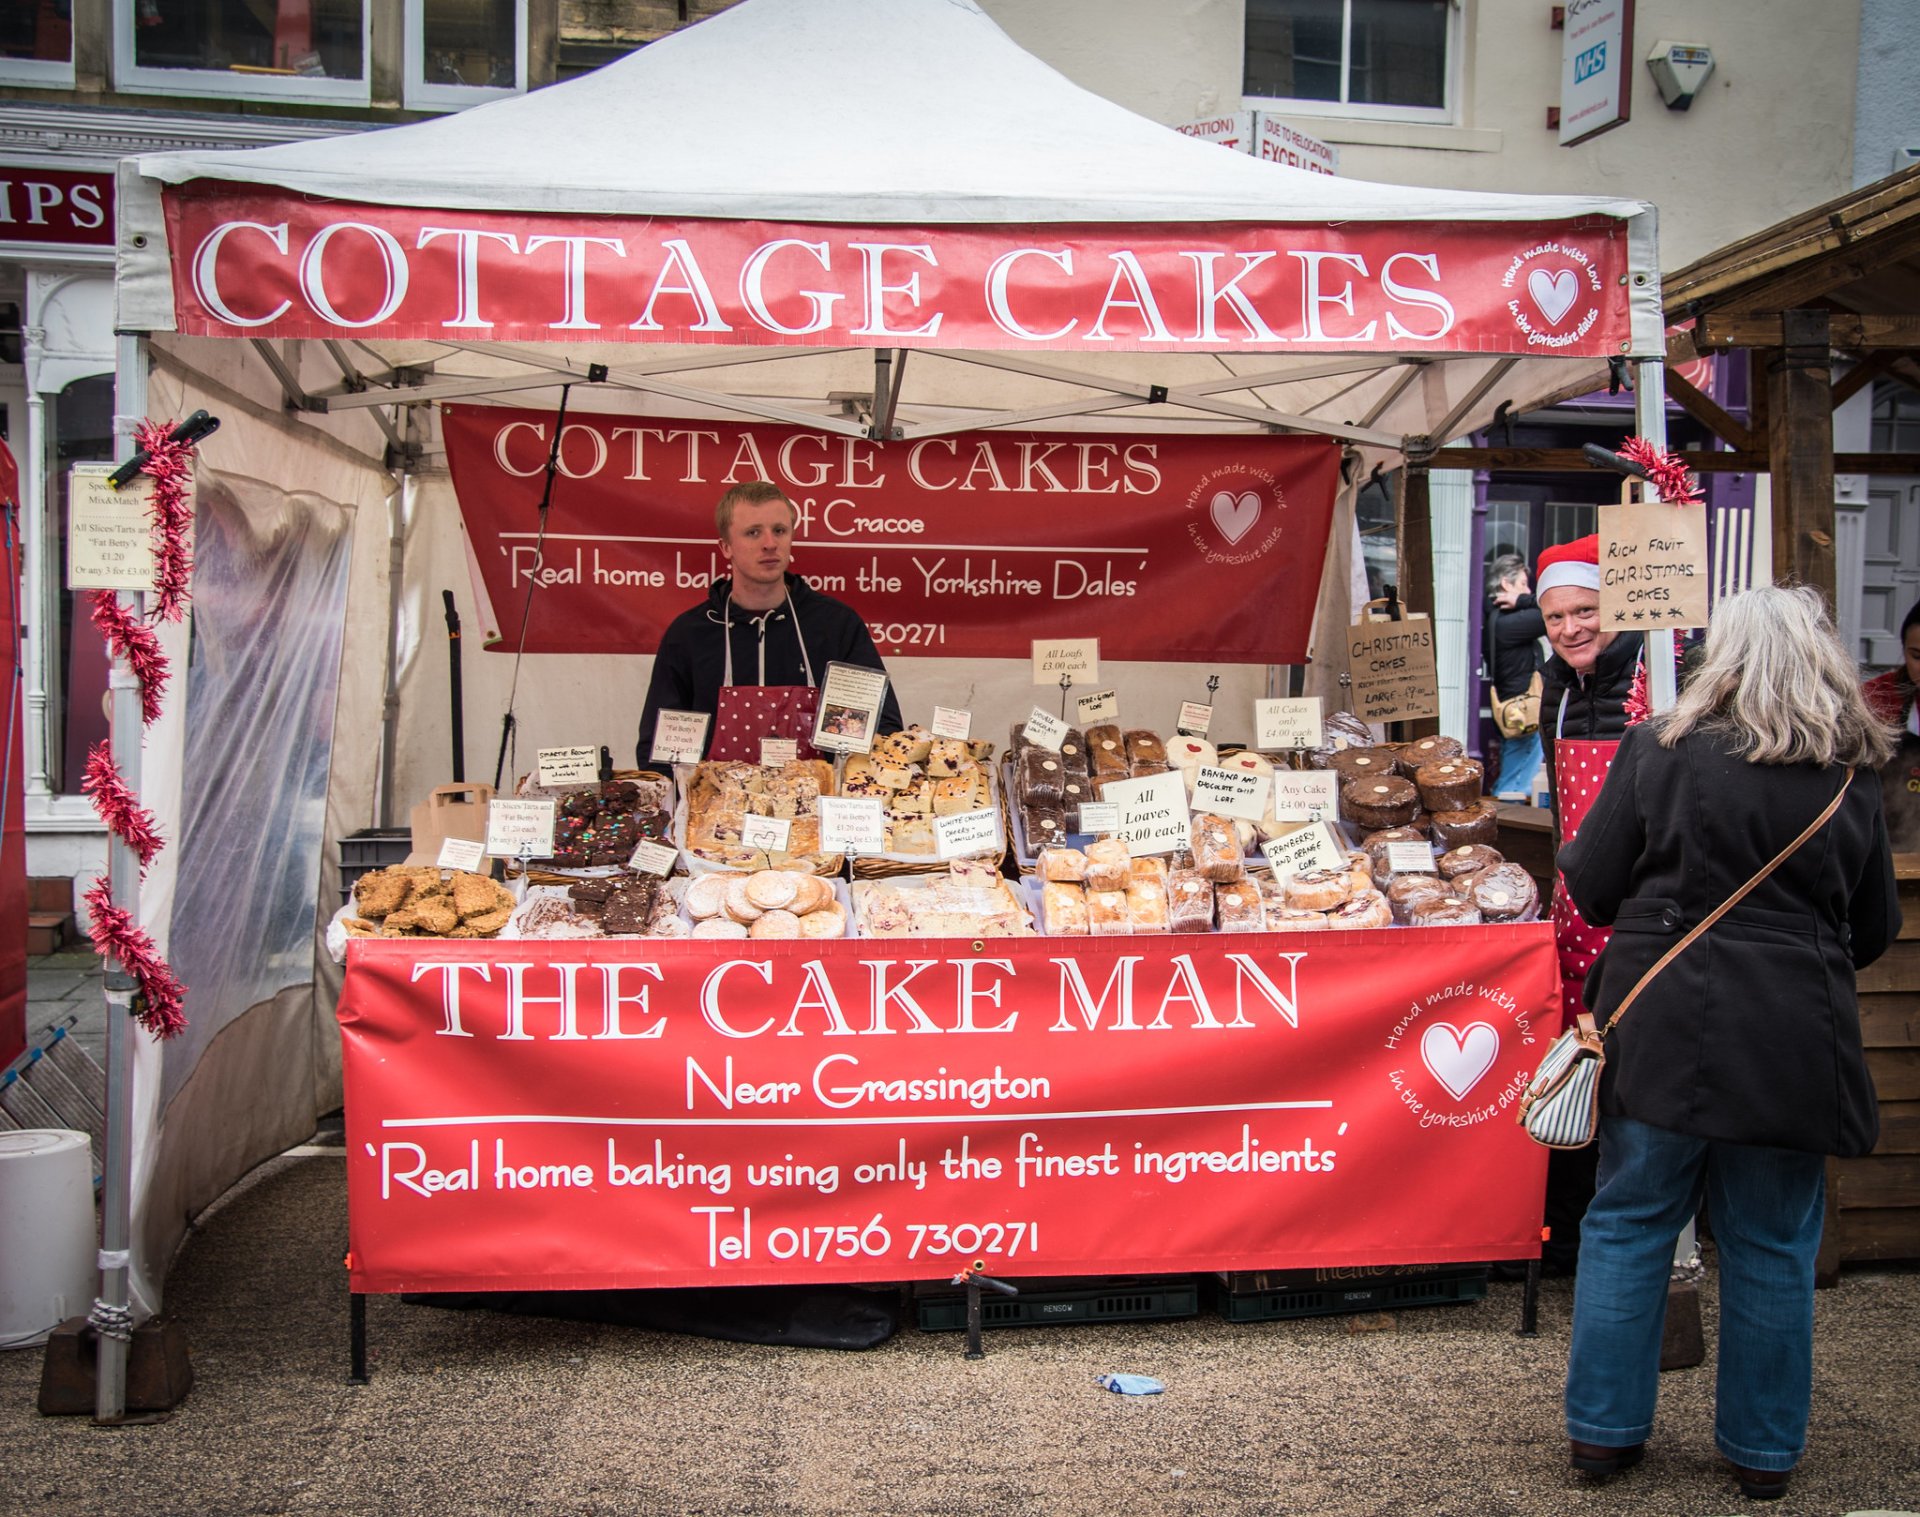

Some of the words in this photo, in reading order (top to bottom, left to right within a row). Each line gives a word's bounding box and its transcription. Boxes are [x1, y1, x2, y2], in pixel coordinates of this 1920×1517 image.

[1576, 43, 1606, 82] NHS
[1282, 126, 1291, 142] TO
[1291, 132, 1333, 165] RELOCATION)
[0, 181, 105, 229] IPS
[1501, 255, 1525, 288] Hand
[1523, 241, 1559, 260] made
[1561, 245, 1588, 266] with
[1586, 263, 1602, 292] love
[191, 220, 944, 338] COTTAGE
[984, 247, 1455, 344] CAKES
[1507, 300, 1519, 316] in
[1516, 313, 1532, 334] the
[1527, 329, 1579, 348] yorkshire
[1577, 308, 1599, 337] dales
[493, 421, 886, 488] COTTAGE
[907, 438, 1162, 496] CAKES
[1185, 474, 1210, 510] Hand
[1211, 462, 1246, 479] made
[1249, 466, 1275, 486] with
[1272, 485, 1288, 510] love
[88, 496, 139, 505] Mix&Match
[823, 498, 925, 536] Cracoe
[74, 524, 87, 532] All
[108, 539, 138, 549] Betty's
[1187, 522, 1198, 537] in
[1193, 535, 1209, 553] the
[1205, 549, 1262, 565] yorkshire
[1261, 526, 1282, 553] dales
[1607, 542, 1638, 559] RICH
[1648, 538, 1685, 551] FRUIT
[101, 553, 125, 561] £1.20
[75, 566, 86, 574] Or
[88, 568, 102, 576] any
[113, 567, 125, 575] for
[594, 548, 666, 587] home
[676, 551, 732, 590] baki
[856, 556, 903, 593] the
[912, 557, 1042, 598] Yorkshire
[1604, 564, 1695, 586] CHRISTMAS
[1626, 587, 1670, 603] CAKES
[866, 622, 945, 647] 30271
[1351, 632, 1430, 658] CHRISTMAS
[1045, 650, 1058, 659] All
[1370, 657, 1406, 672] CAKES
[1042, 662, 1065, 671] £3.00
[1067, 661, 1087, 671] each
[1365, 690, 1397, 704] LARGE
[1266, 706, 1280, 714] All
[1282, 705, 1308, 715] Cakes
[1278, 715, 1298, 727] only
[1265, 729, 1290, 738] £4.00
[1292, 728, 1312, 738] each
[1197, 780, 1233, 792] CHOCOLATE
[1201, 768, 1239, 782] BANANA
[1242, 775, 1258, 784] AND
[1135, 789, 1155, 805] All
[1214, 794, 1235, 804] LOAF
[1281, 785, 1301, 796] Any
[1303, 785, 1327, 794] Cake
[1280, 800, 1306, 809] £4.00
[1309, 801, 1329, 810] each
[940, 816, 963, 828] WHITE
[964, 811, 995, 822] CHOCOLATE
[1125, 808, 1170, 825] Loaves
[1155, 821, 1185, 838] each
[1267, 831, 1315, 858] CRANBERRY
[1275, 855, 1292, 867] AND
[1294, 841, 1322, 860] ORANGE
[410, 961, 668, 1041] THE
[699, 958, 1019, 1039] CAKE
[1048, 952, 1308, 1033] MAN
[1384, 1002, 1423, 1050] Hand
[1425, 981, 1473, 1006] made
[1479, 985, 1517, 1013] with
[1515, 1011, 1536, 1045] love
[686, 1055, 801, 1110] Near
[813, 1054, 1051, 1109] Grassington
[1389, 1069, 1405, 1091] in
[1401, 1089, 1424, 1114] the
[1419, 1103, 1499, 1128] yorkshire
[1498, 1070, 1528, 1109] dales
[494, 1138, 594, 1190] home
[607, 1138, 732, 1195] baking
[747, 1153, 840, 1195] using
[853, 1138, 928, 1190] only
[939, 1136, 1002, 1180] the
[1015, 1132, 1120, 1188] finest
[690, 1206, 751, 1268] Tel
[767, 1213, 892, 1263] 01756
[905, 1221, 1039, 1260] 730271
